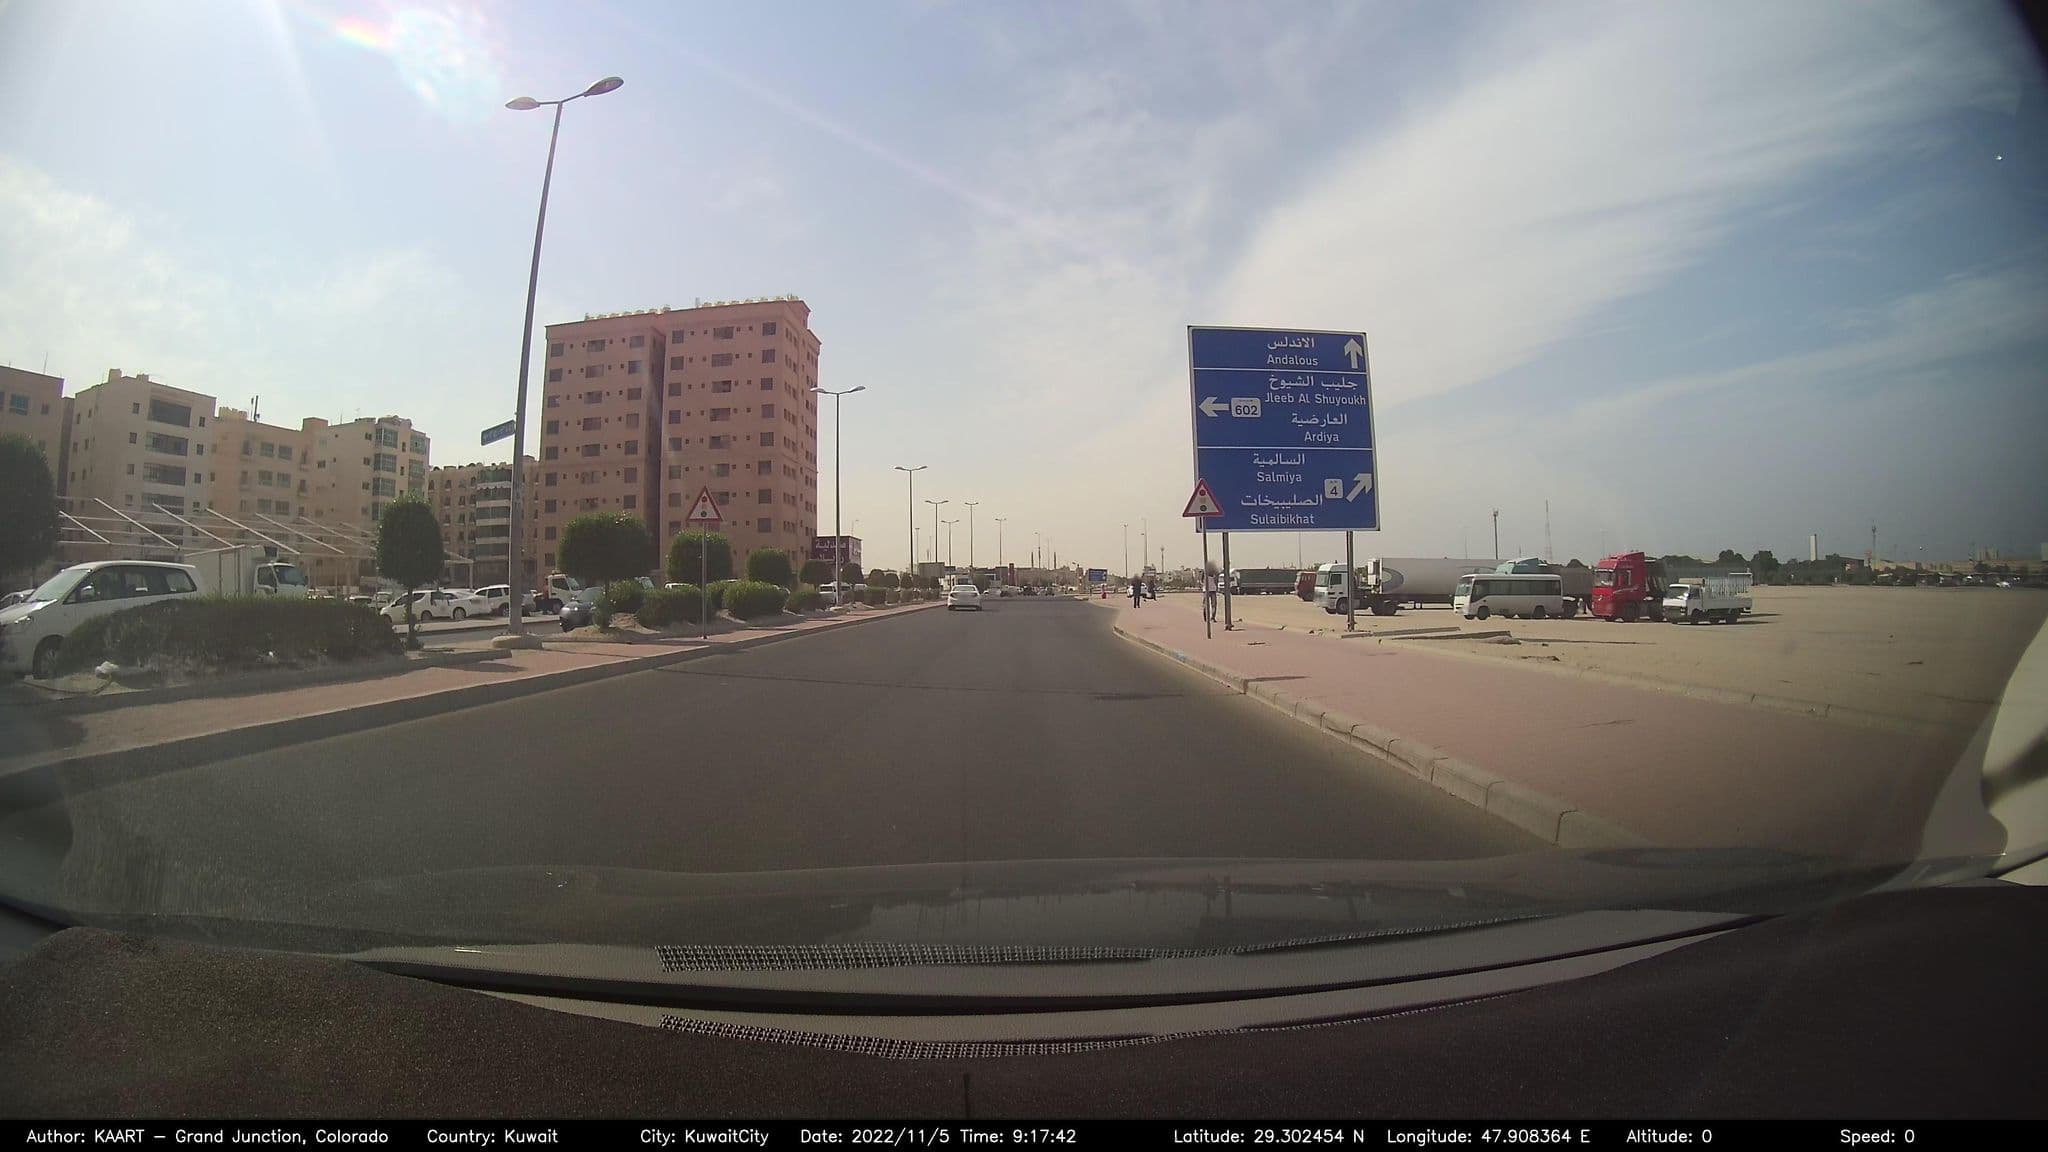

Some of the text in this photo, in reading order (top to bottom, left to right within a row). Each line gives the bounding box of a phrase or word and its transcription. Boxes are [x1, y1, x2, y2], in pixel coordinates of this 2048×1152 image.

[1267, 336, 1315, 350] الاندلس
[1266, 354, 1319, 366] Andalous
[1269, 374, 1358, 390] جليب الشيوخ
[1264, 392, 1366, 406] Jleeb Al Shuyoukh
[1235, 405, 1258, 415] 602
[1291, 412, 1348, 427] العارضية
[1304, 431, 1339, 444] Ardiya
[1253, 453, 1305, 468] السالمية
[1256, 471, 1302, 485] Salmiya
[1330, 486, 1338, 496] 4
[1241, 494, 1323, 509] الصليبيخات
[1250, 513, 1315, 525] Sulaibikhat
